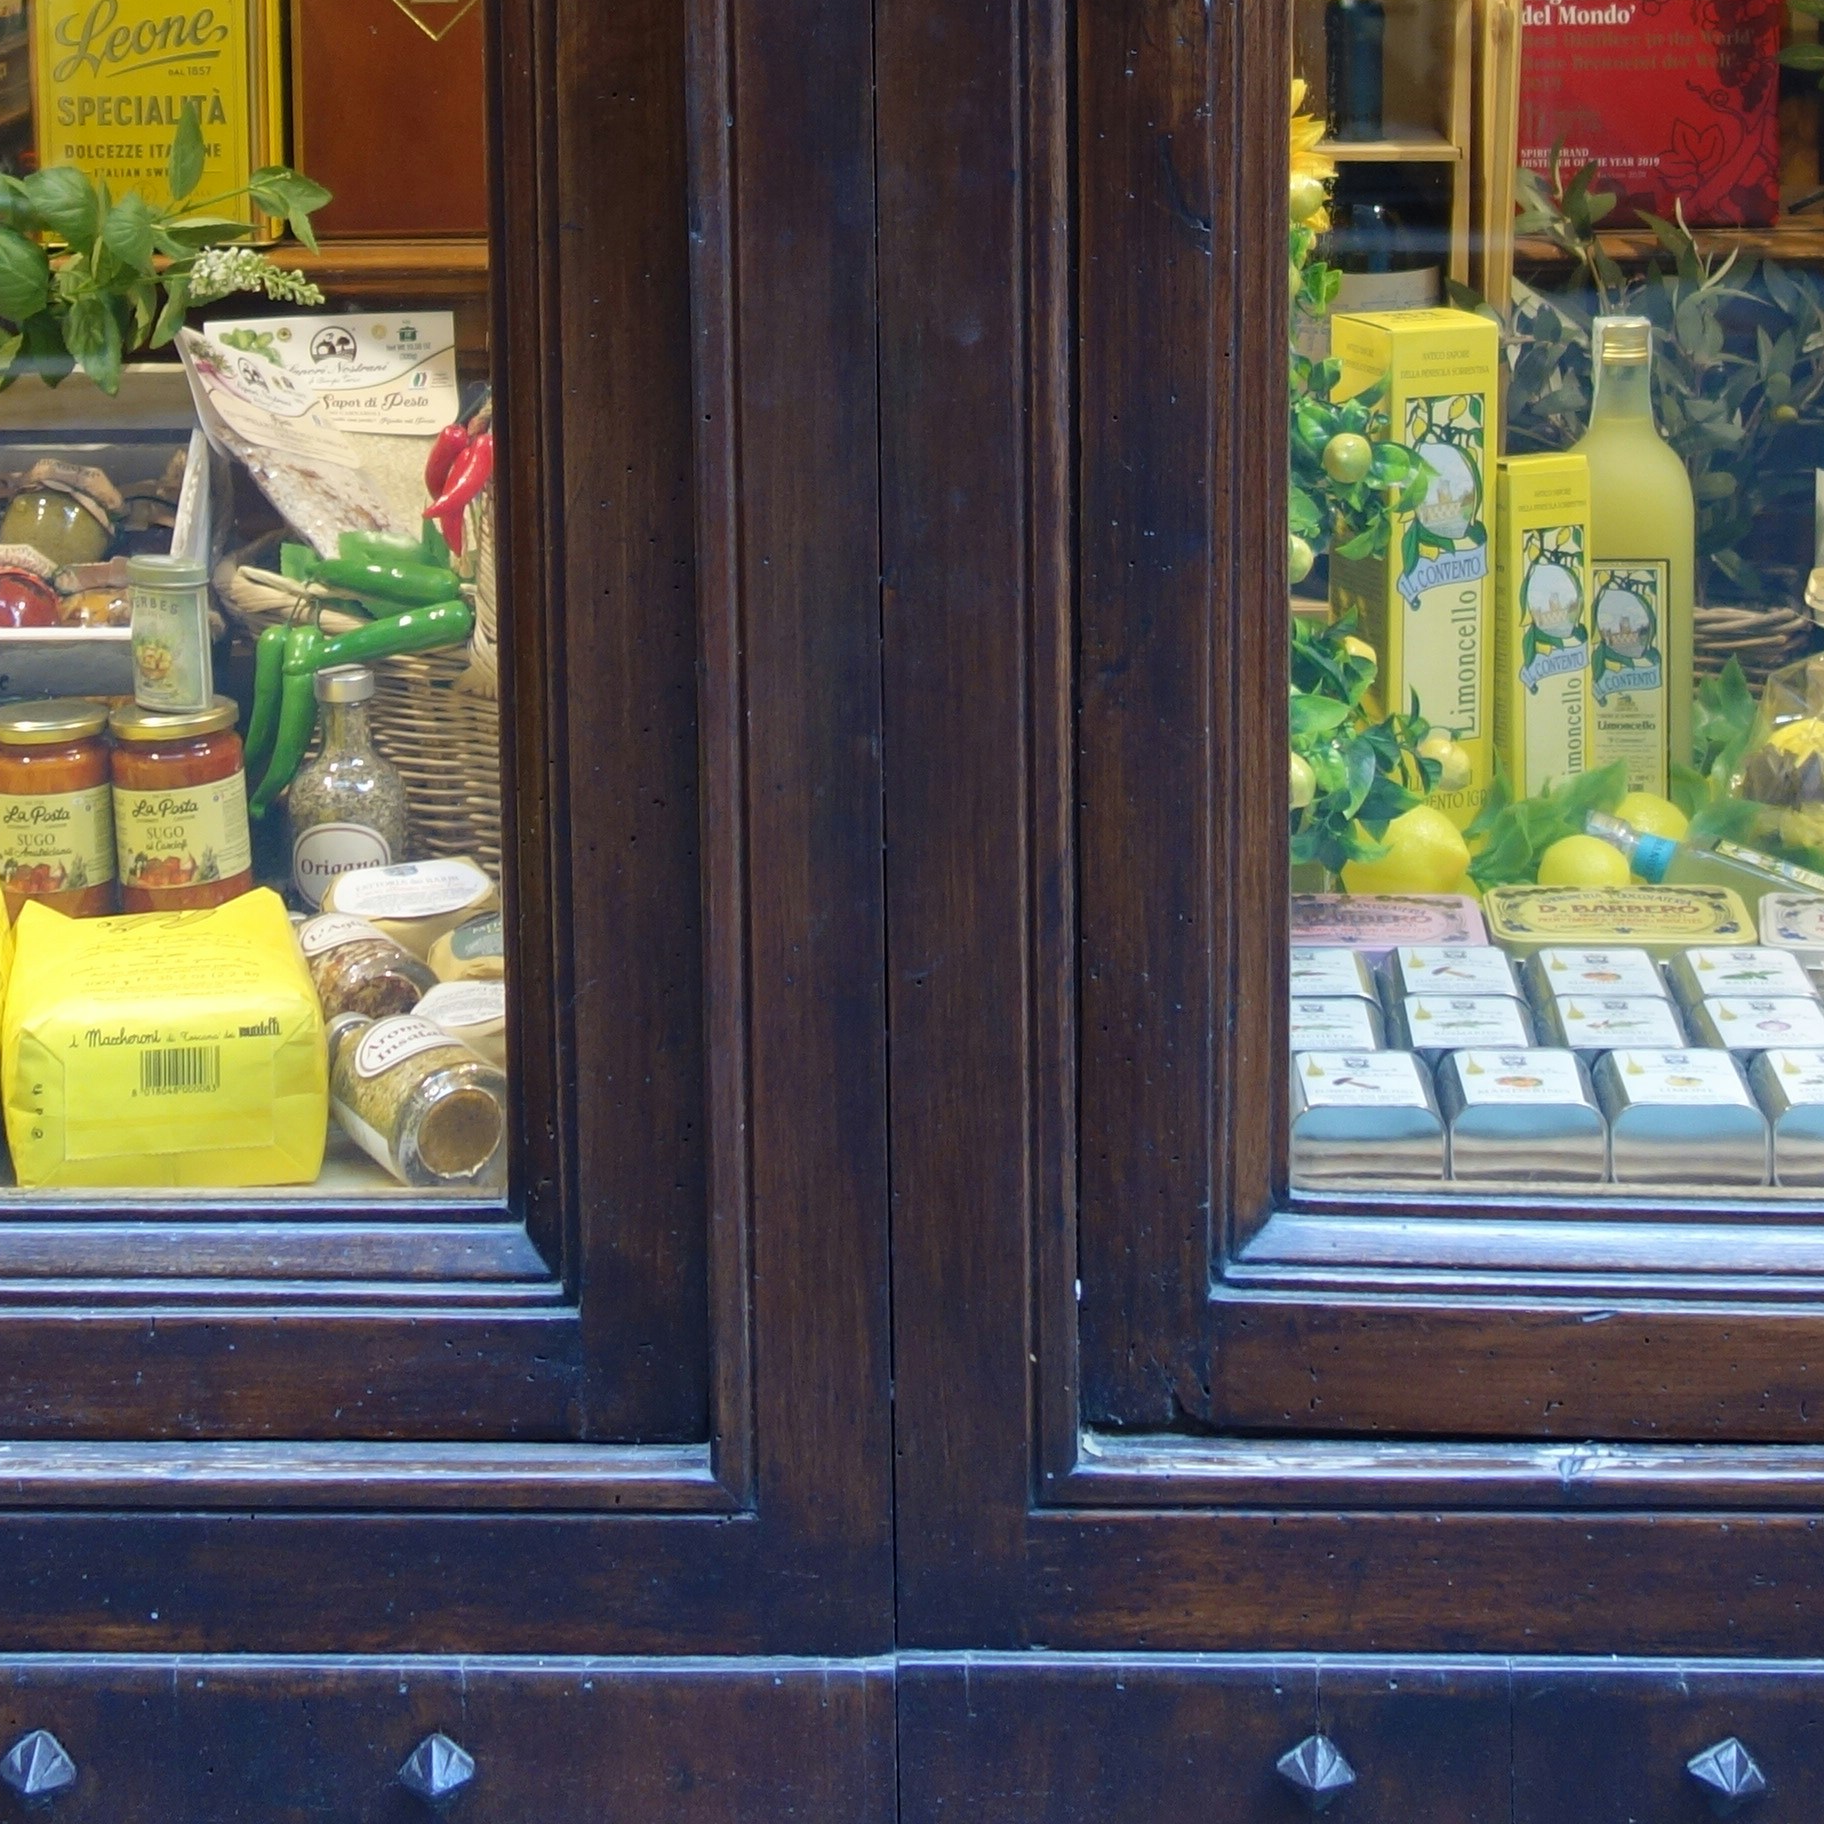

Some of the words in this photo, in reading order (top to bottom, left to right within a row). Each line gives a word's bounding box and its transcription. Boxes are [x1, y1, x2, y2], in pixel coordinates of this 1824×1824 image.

[1521, 4, 1551, 26] del
[187, 67, 212, 77] 1857
[65, 143, 144, 158] DOLCEZZE
[1609, 157, 1635, 167] YEAR
[1638, 156, 1660, 167] 2019
[94, 169, 139, 179] ITALIAN
[331, 360, 389, 374] Nostrani
[322, 391, 361, 411] Sapor
[363, 395, 377, 408] di
[382, 391, 429, 410] Pesto
[1401, 575, 1417, 596] IL
[1418, 556, 1482, 590] CONVENTO
[1449, 590, 1477, 733] Limoncello
[1526, 666, 1539, 680] IL
[1535, 651, 1586, 676] CONVENTO
[1605, 671, 1658, 689] CONVENTO
[1597, 720, 1657, 732] Limoncello
[132, 799, 158, 818] La
[158, 798, 200, 818] Posta
[1463, 792, 1488, 810] IGP
[3, 806, 29, 824] La
[30, 806, 71, 825] Posta
[17, 833, 56, 847] SUGO
[146, 826, 185, 840] SUGO
[1538, 904, 1564, 914] D.
[1567, 902, 1700, 915] BARBERO
[83, 1027, 162, 1049] Maccheroni
[238, 1017, 283, 1038] martelli
